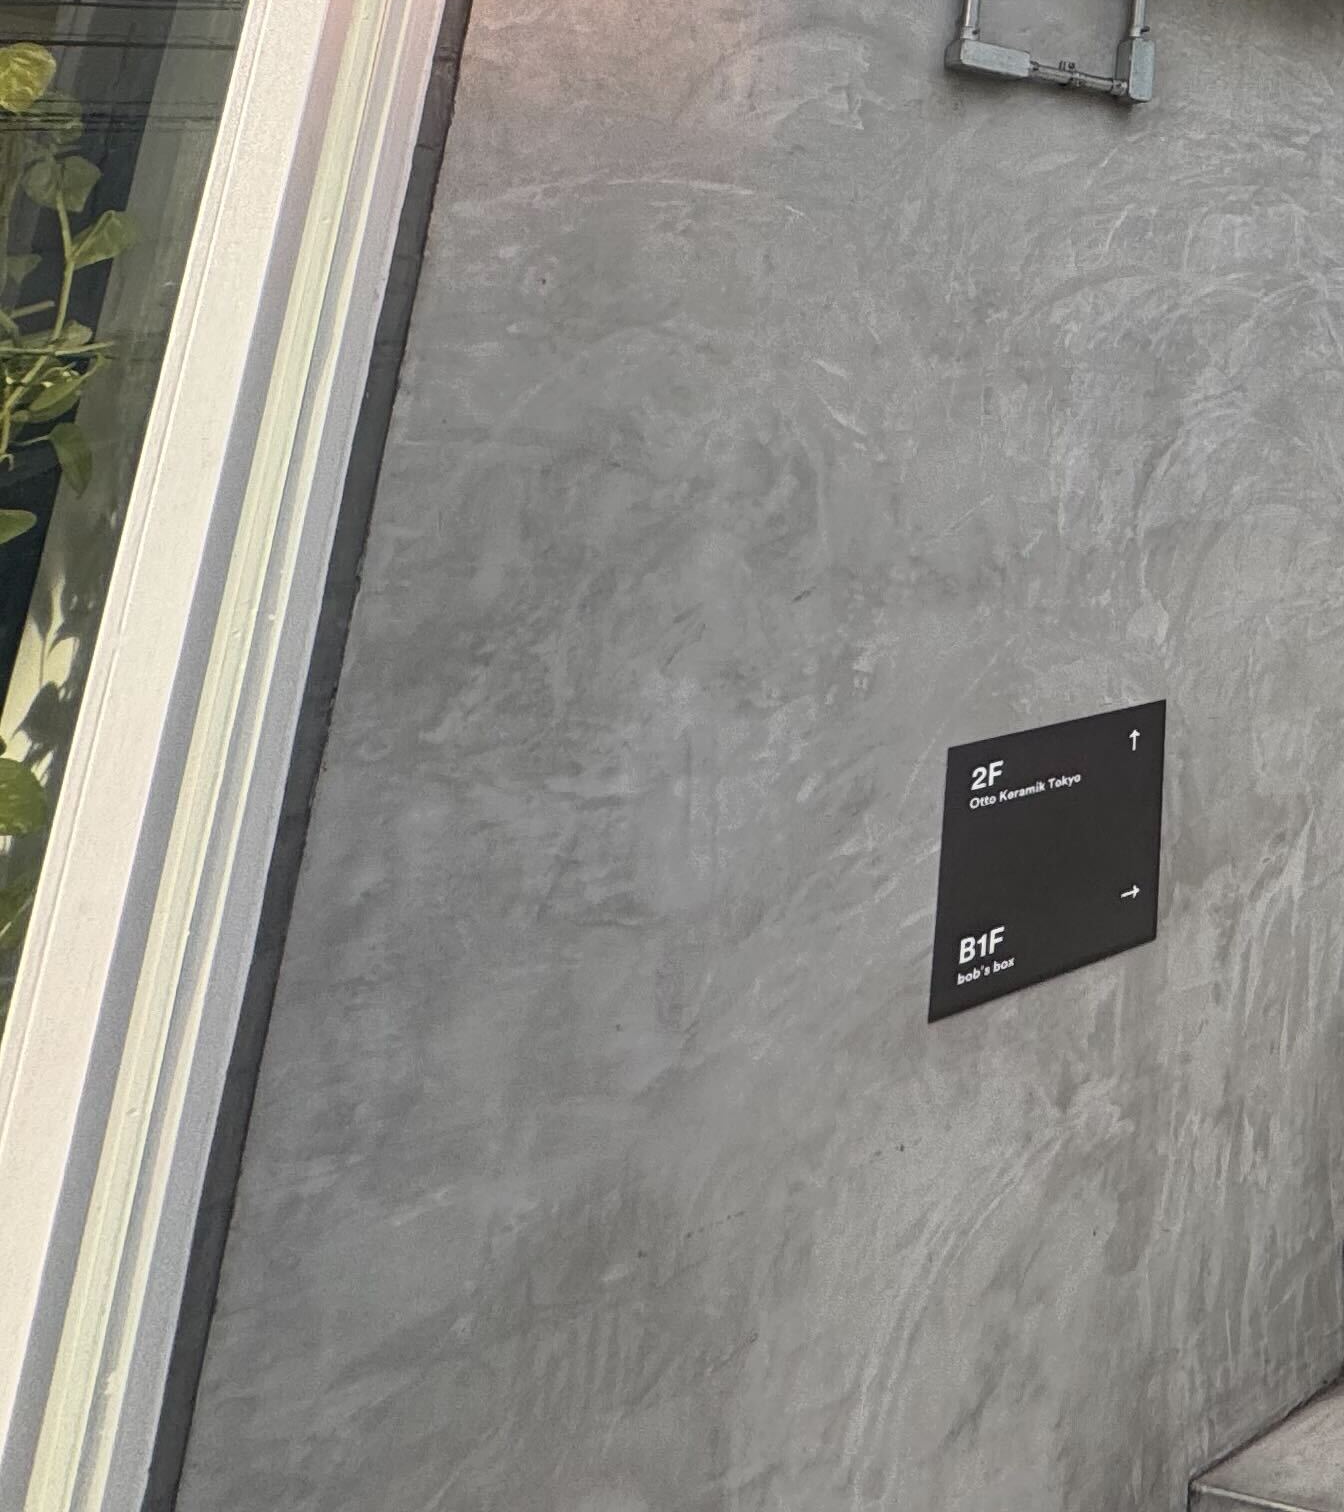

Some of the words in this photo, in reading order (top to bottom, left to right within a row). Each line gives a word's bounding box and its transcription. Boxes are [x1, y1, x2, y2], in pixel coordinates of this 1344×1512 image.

[969, 794, 997, 810] Otto
[999, 781, 1046, 803] Keramik
[1048, 773, 1082, 790] Tokyo
[970, 760, 1004, 791] 2F
[958, 926, 1005, 965] B1F
[956, 965, 991, 985] bob's
[993, 956, 1015, 973] box
